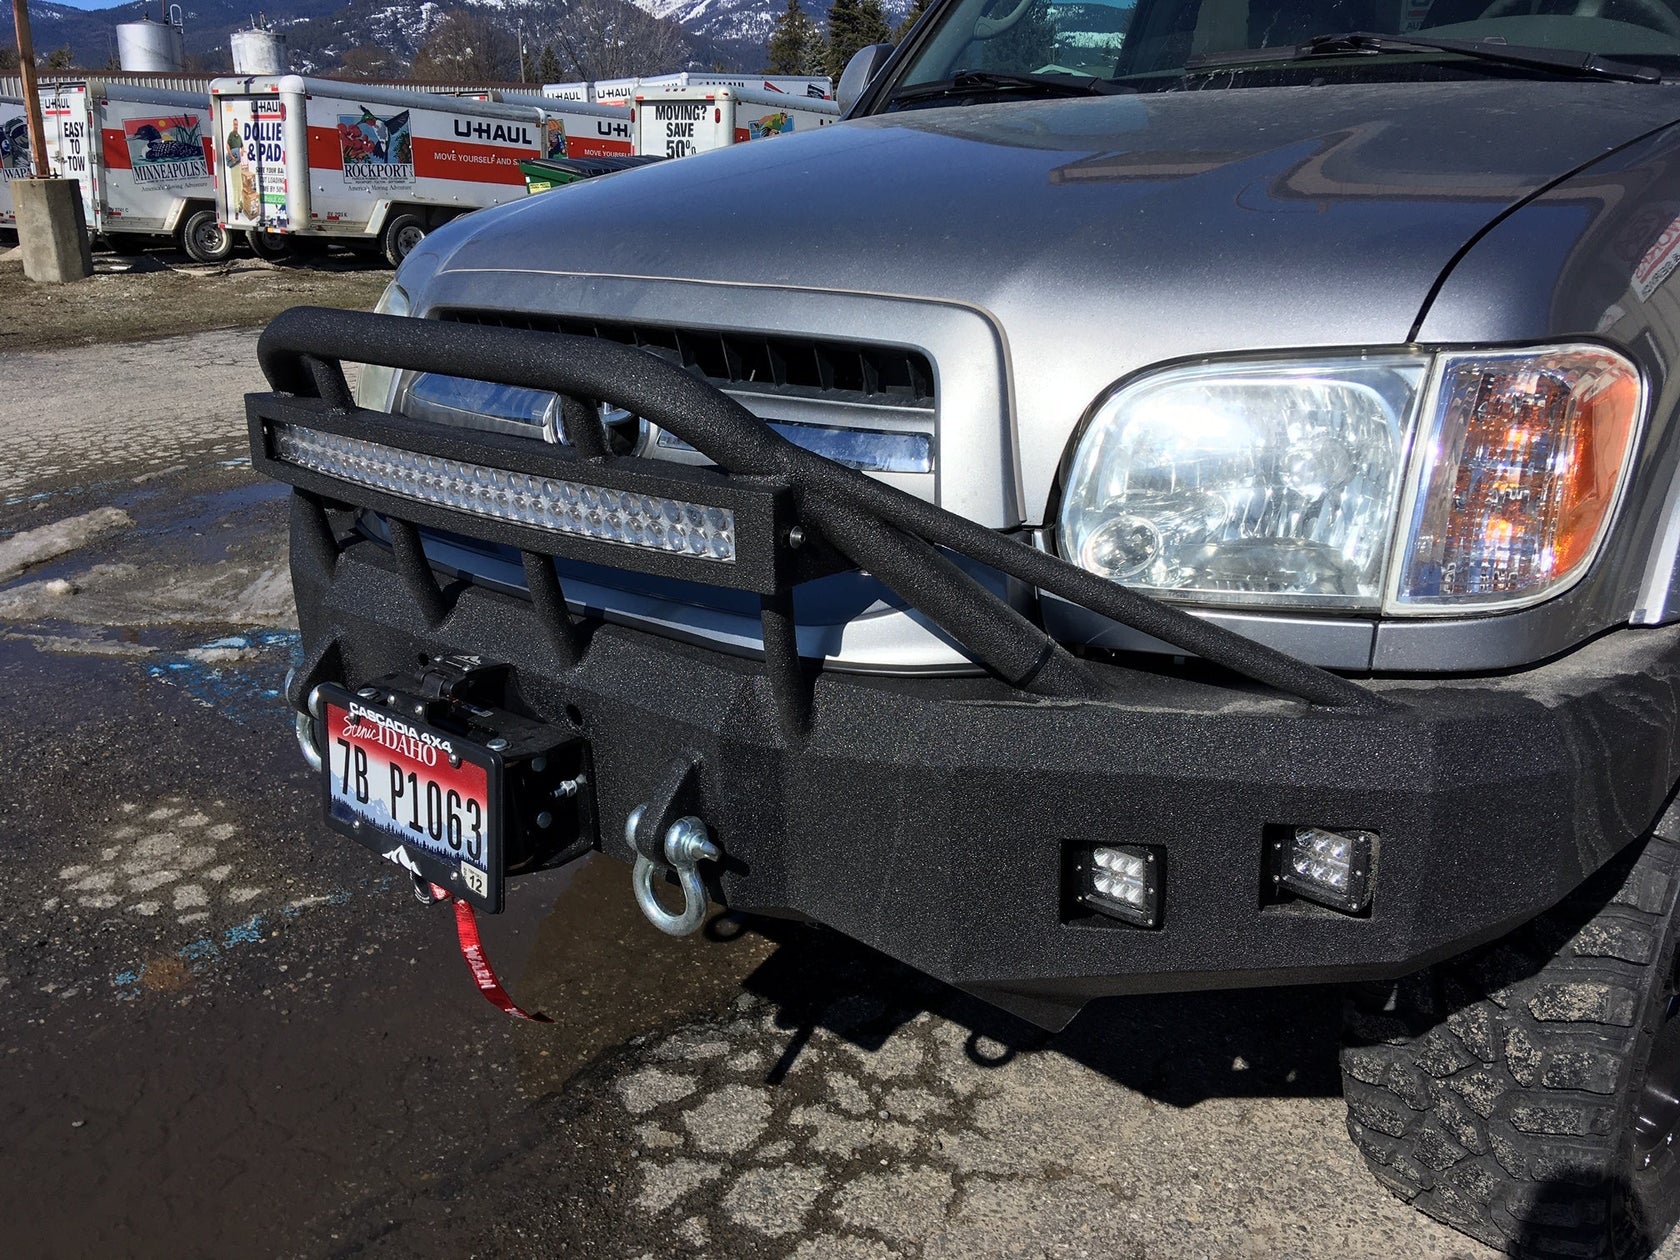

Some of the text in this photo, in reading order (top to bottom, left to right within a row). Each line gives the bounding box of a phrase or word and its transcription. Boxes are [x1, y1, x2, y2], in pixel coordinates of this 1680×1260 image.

[45, 98, 70, 109] U-HAUL
[655, 105, 708, 121] MOVING?
[64, 121, 84, 138] EASY
[453, 119, 533, 145] U-HAUL
[666, 122, 694, 138] SAVE
[69, 139, 81, 155] TO
[247, 144, 256, 161] &
[584, 148, 602, 157] MOVE
[67, 156, 85, 171] TOW
[434, 152, 457, 161] MOVE
[458, 154, 495, 164] YOURSELF
[497, 157, 511, 166] AND
[133, 161, 201, 181] MINNEAPOLIS
[344, 164, 408, 178] ROCKPORT
[348, 701, 453, 753] CASCADIA 4X4
[342, 715, 437, 767] Scenic IDAHO
[336, 737, 481, 861] 7B P1063
[470, 875, 483, 894] 12
